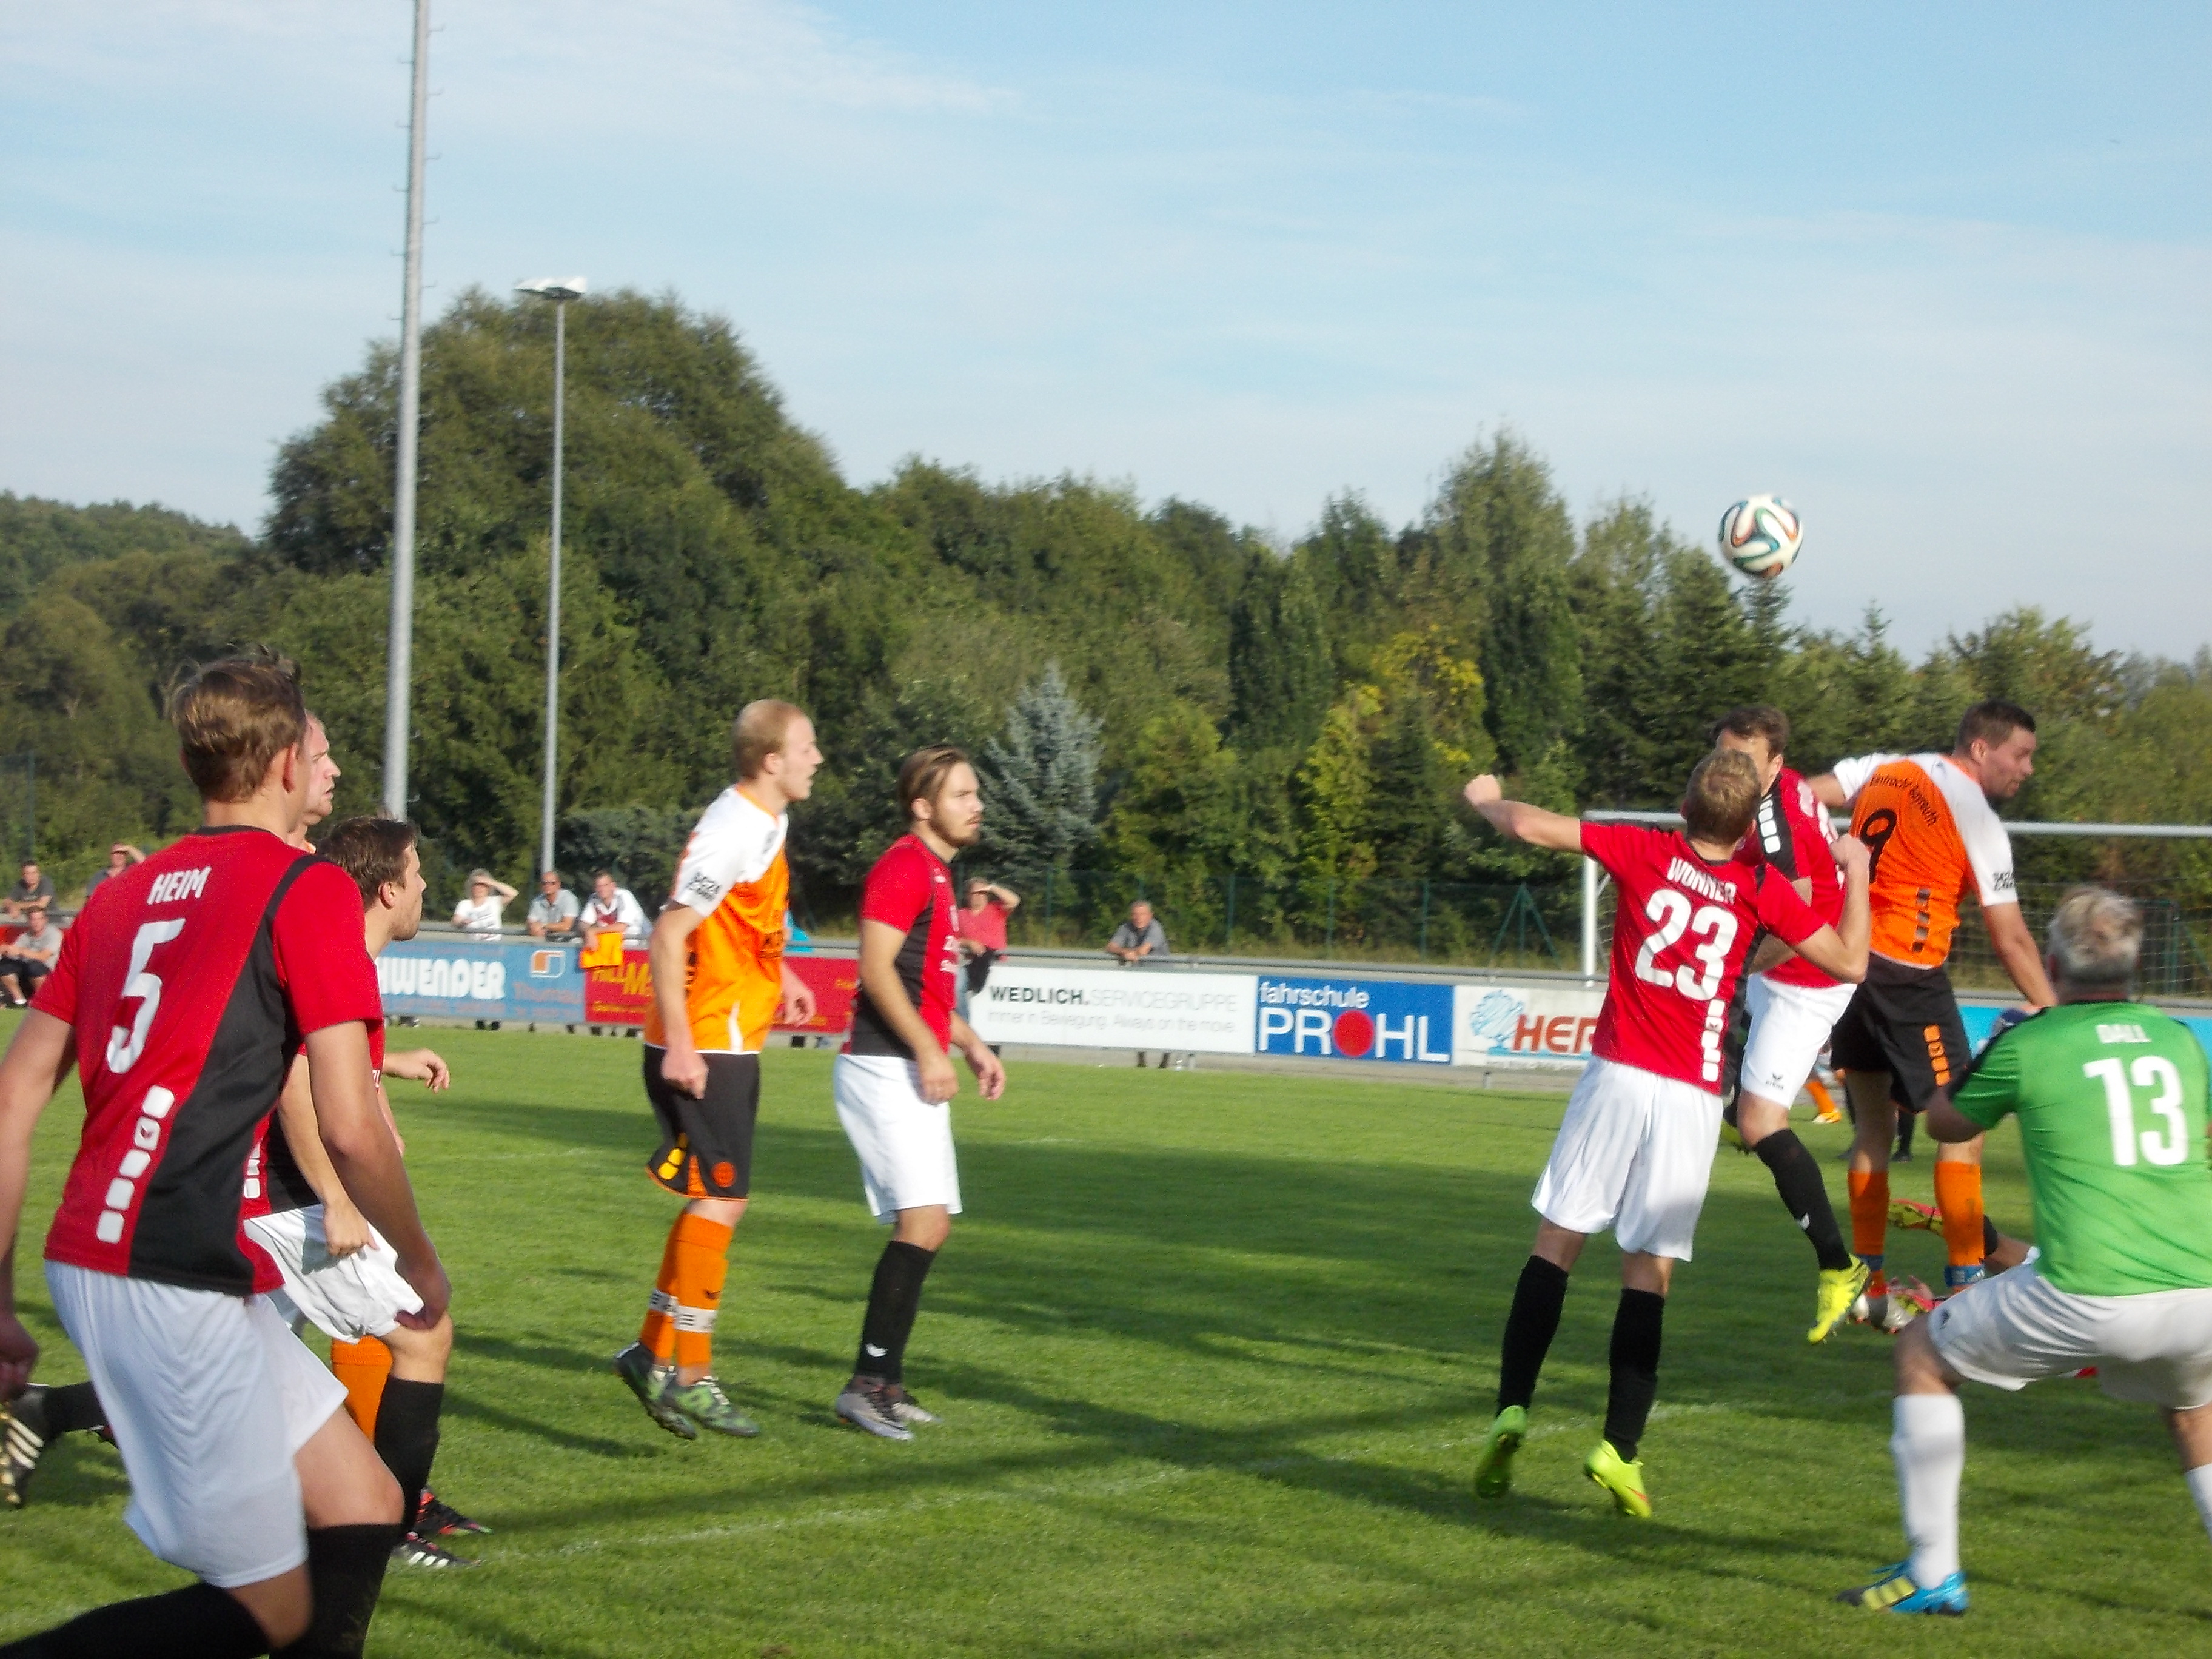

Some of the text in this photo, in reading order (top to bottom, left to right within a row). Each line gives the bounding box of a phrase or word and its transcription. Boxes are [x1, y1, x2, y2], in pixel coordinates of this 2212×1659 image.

[147, 866, 212, 905] HEIM
[1860, 808, 1897, 883] 9
[1635, 888, 1738, 1000] 23
[107, 918, 186, 1074] 5
[1260, 981, 1370, 1009] fahrschule
[2082, 1055, 2188, 1167] 13
